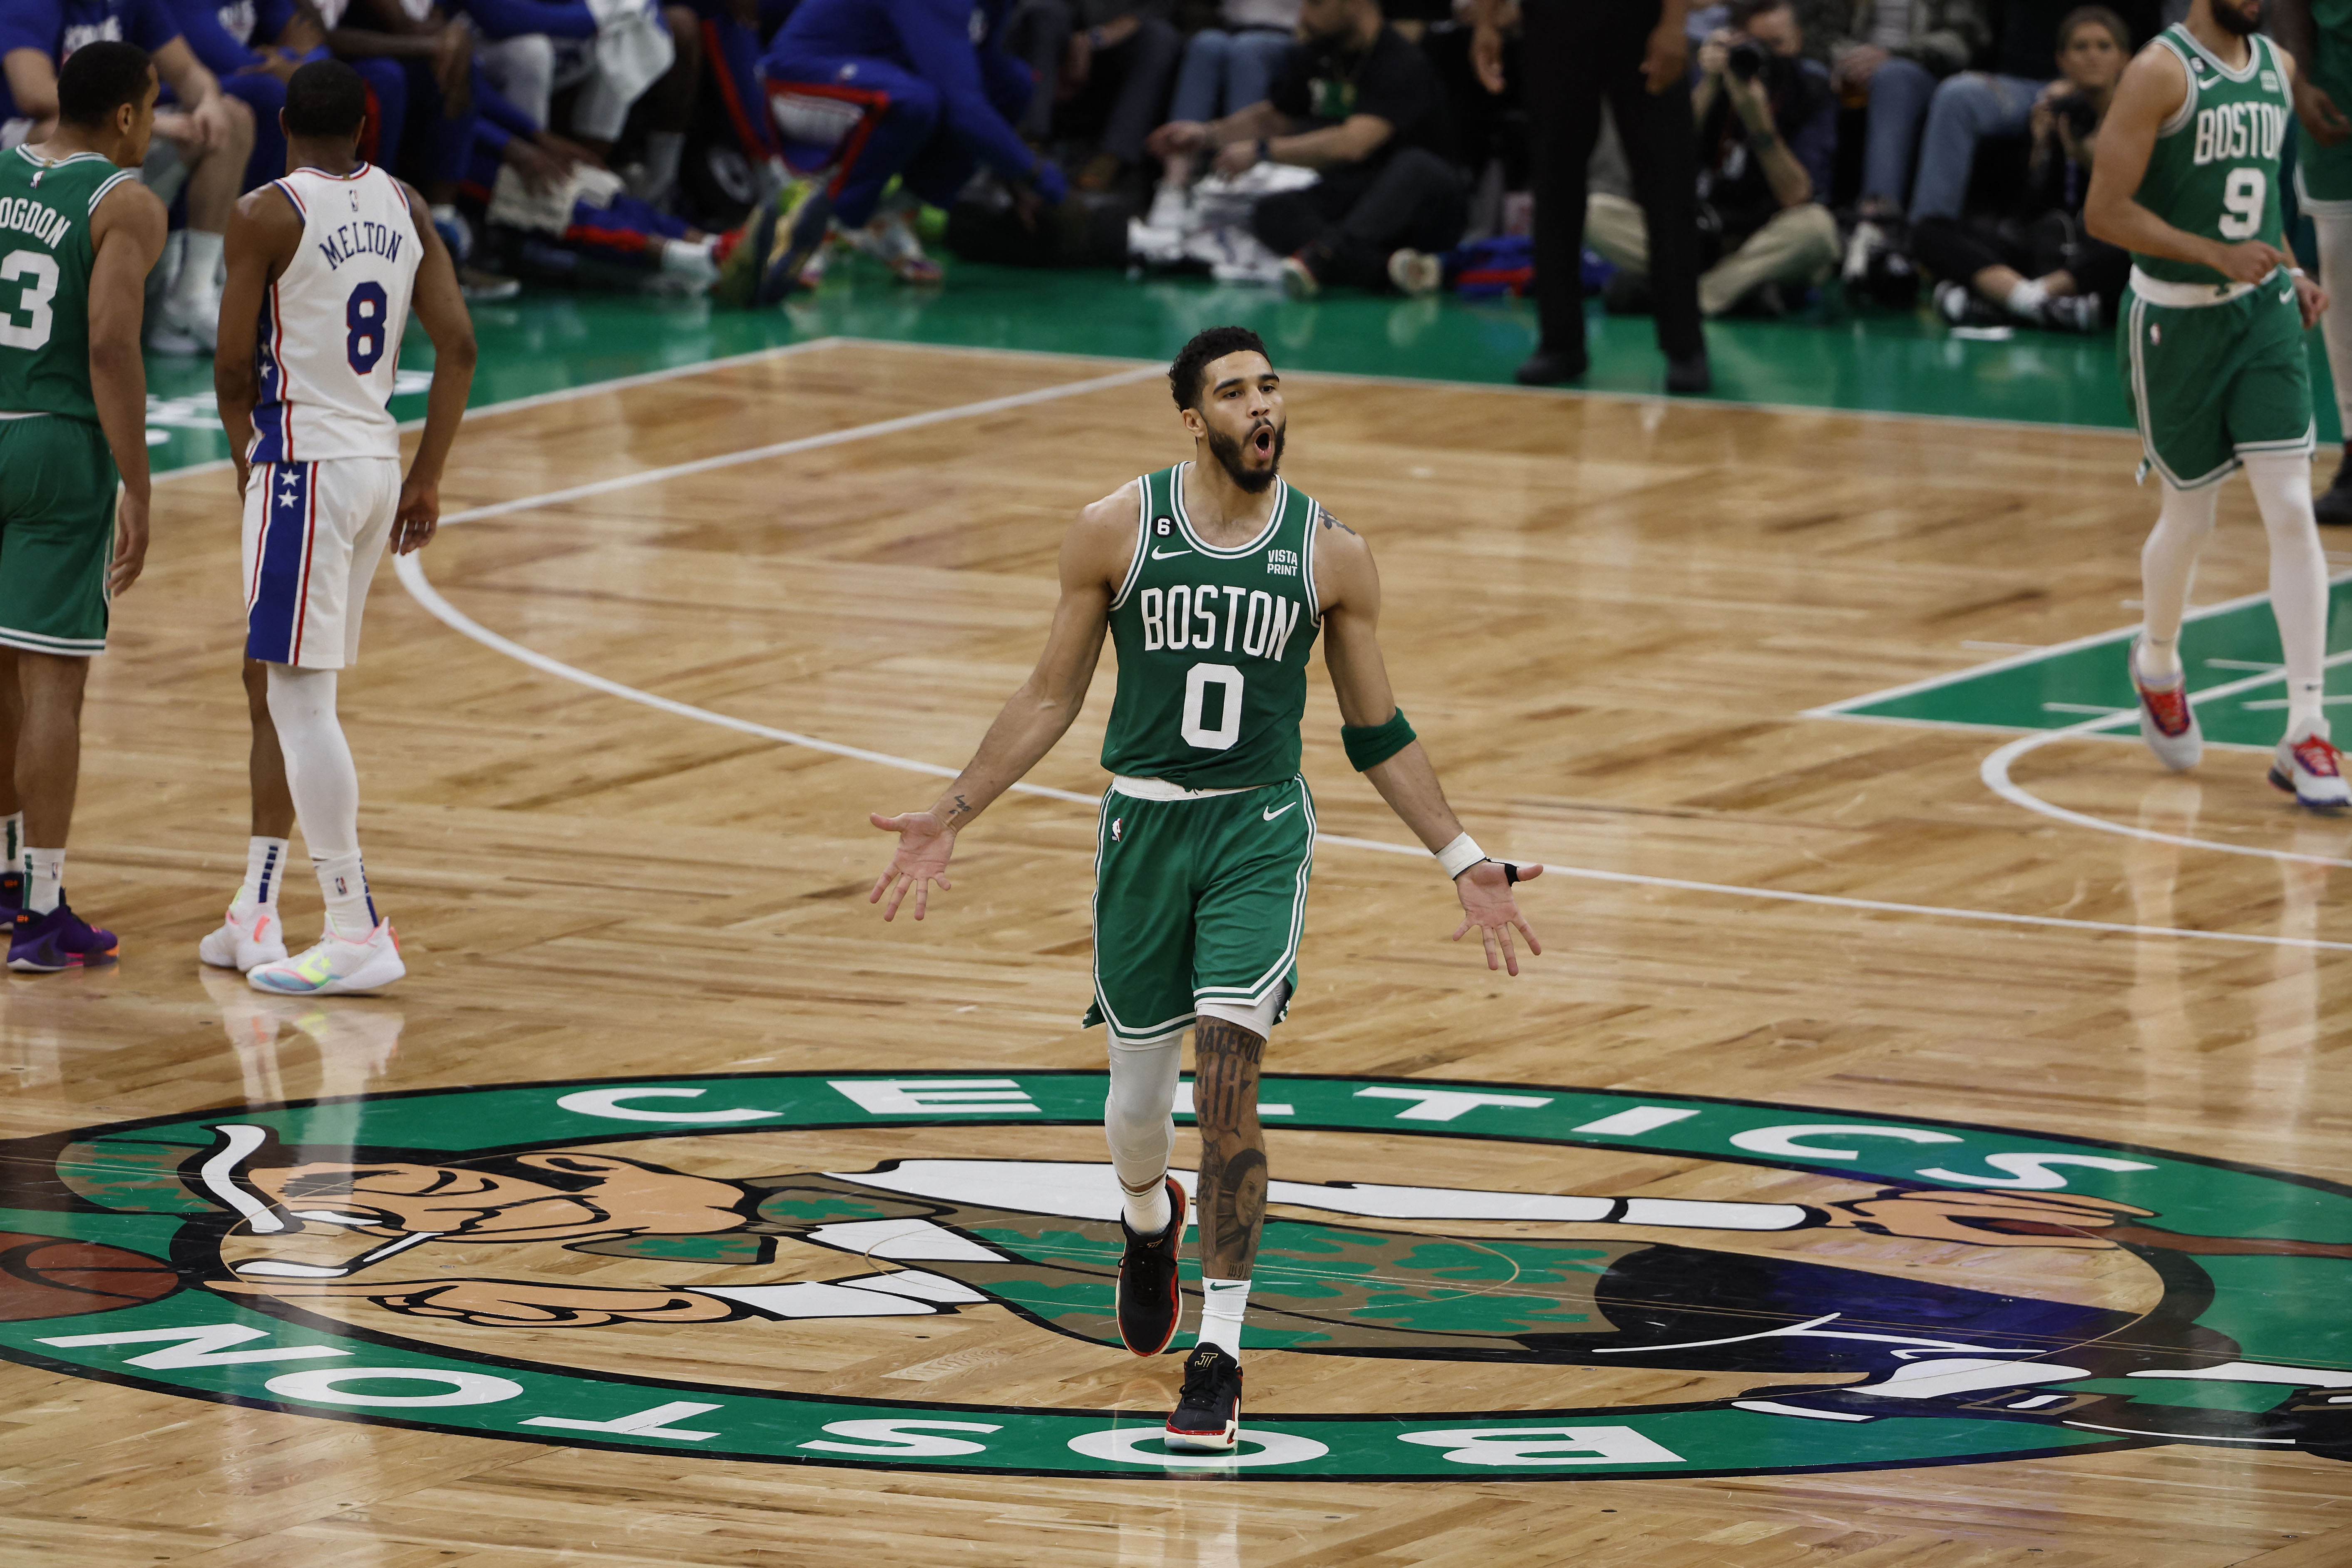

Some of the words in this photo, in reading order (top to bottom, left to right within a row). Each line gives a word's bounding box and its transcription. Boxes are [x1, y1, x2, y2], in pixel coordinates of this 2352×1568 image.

[2218, 167, 2266, 240] 9
[318, 221, 402, 271] MELTON
[347, 281, 387, 376] 8
[1157, 518, 1170, 535] 6
[1268, 549, 1298, 566] VISTA
[1267, 563, 1298, 577] PRINT
[1141, 584, 1300, 662] BOSTON
[1181, 662, 1244, 750] 0
[33, 1322, 1687, 1467] BOSTON
